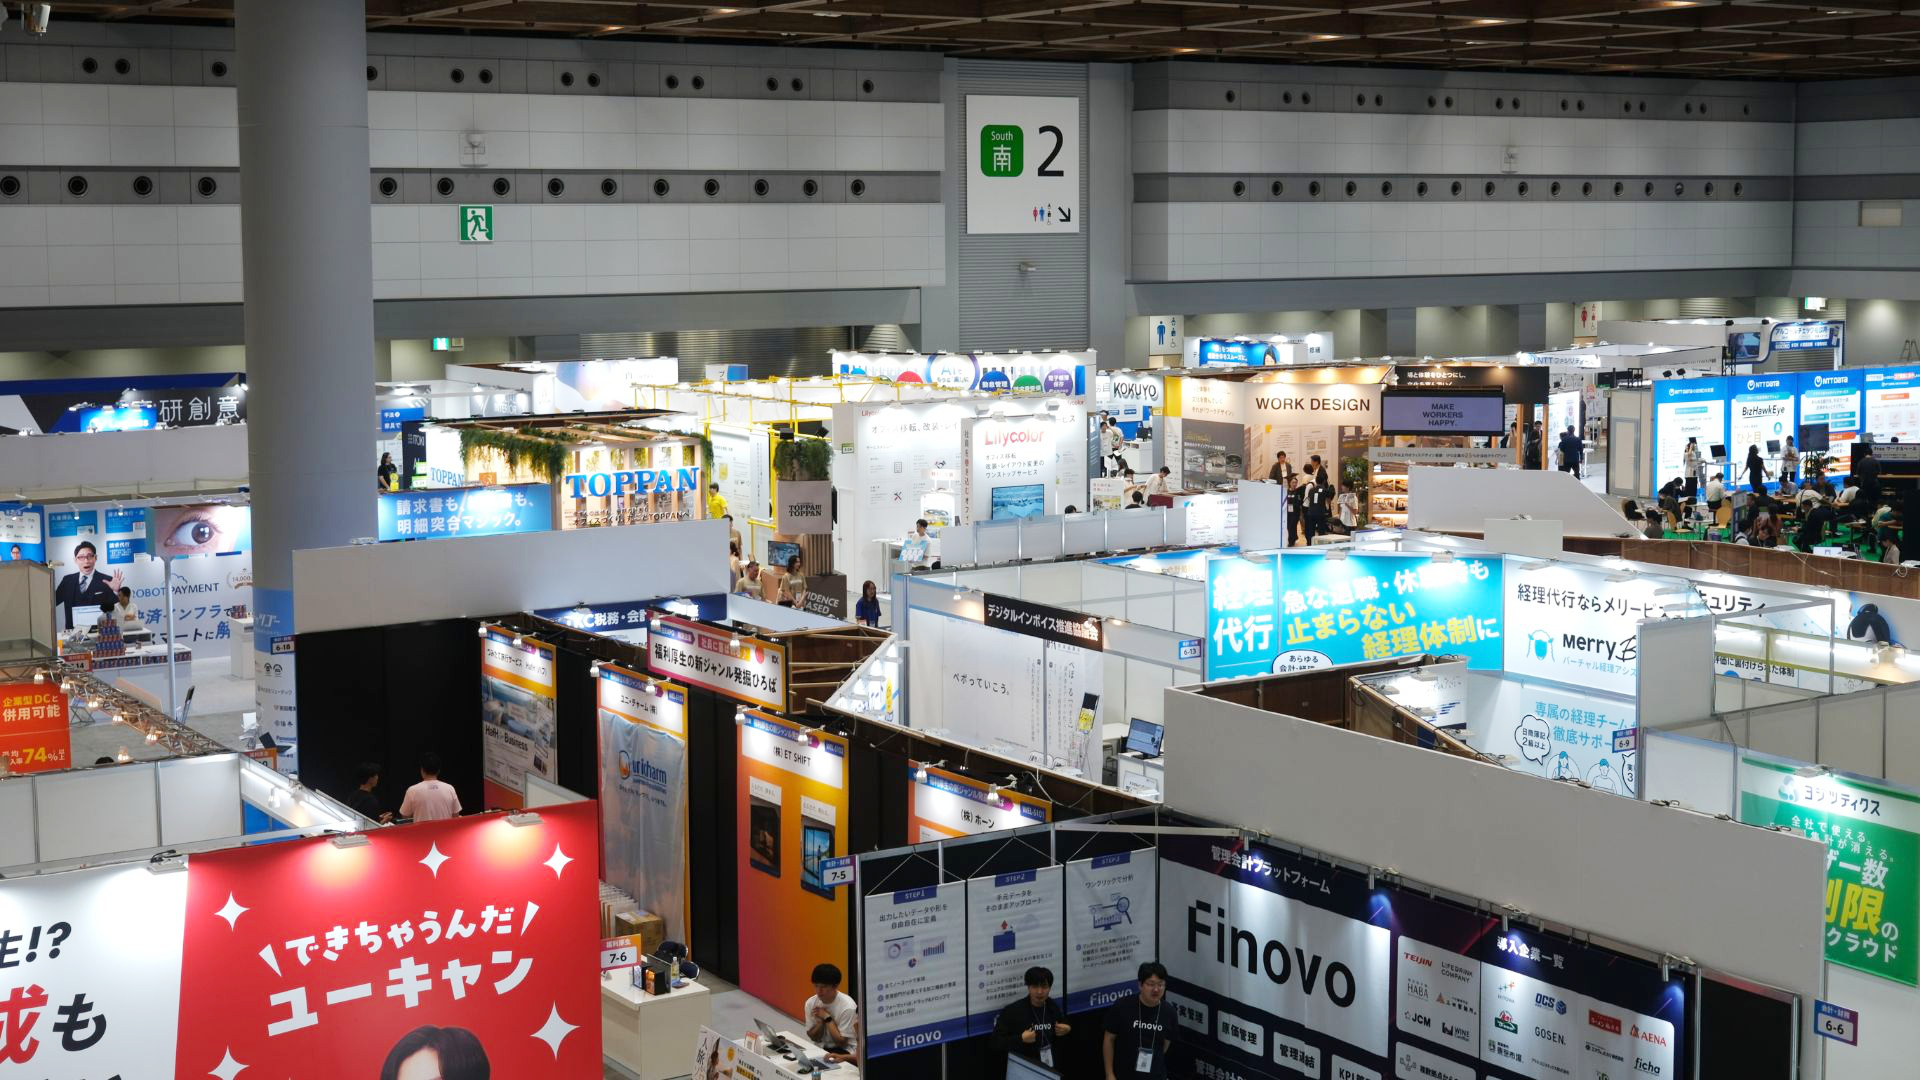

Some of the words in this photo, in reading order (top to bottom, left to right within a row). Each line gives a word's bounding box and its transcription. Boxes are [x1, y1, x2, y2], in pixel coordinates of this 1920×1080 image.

[991, 131, 1013, 141] South
[993, 144, 1011, 172] 南
[1038, 126, 1064, 176] 2
[1113, 382, 1157, 398] KOKUYO
[1256, 397, 1305, 410] WORK
[1310, 398, 1370, 411] DESIGN
[1742, 405, 1785, 416] BizHawkEye
[985, 430, 1044, 447] Lilycolor
[431, 467, 465, 488] TOPPAN
[565, 466, 700, 498] TOPPAN
[397, 512, 521, 534] 明細突合マジック。
[171, 583, 219, 596] PAYMENT
[805, 602, 829, 615] ASED
[1286, 602, 1416, 645] 止まらない
[1214, 615, 1273, 655] 代行
[1362, 615, 1500, 660] 経理体制に
[1289, 655, 1319, 664] あらゆる
[654, 643, 777, 693] 福利厚生の新ジャンル発掘ひろば
[3, 704, 61, 722] 併用可能
[505, 732, 528, 751] Business
[1522, 736, 1546, 751] 2級以上
[1619, 739, 1630, 748] 6-9
[784, 749, 792, 759] ET
[793, 752, 811, 767] SHIFT
[961, 808, 973, 824] (株)
[975, 815, 995, 829] ホーン
[832, 869, 847, 881] 7-5
[1211, 844, 1331, 895] 管理会計プラットフォーム
[1005, 874, 1026, 883] STEP2
[1085, 873, 1134, 889] ワンクリックで分析
[905, 890, 925, 899] STEP1
[997, 889, 1032, 901] 手元データを
[986, 897, 1043, 913] そのままアップロード
[879, 904, 948, 923] 出力したいデータや形を
[891, 915, 937, 930] 自由自在に定義
[286, 904, 514, 962] できちゃうんだ
[1187, 899, 1356, 1008] Finovo
[1497, 935, 1565, 970] 導入企業一覧
[1827, 928, 1897, 963] クラウド
[610, 952, 627, 963] 7-6
[1404, 952, 1433, 967] TEIJIN
[1441, 969, 1470, 984] COMPANY
[267, 949, 534, 1037] ユーキャン
[1407, 982, 1429, 999] HABA
[1821, 1004, 1850, 1019] 会計・財務
[1133, 1019, 1163, 1032] Finovo
[1411, 1013, 1431, 1028] JCM
[1826, 1020, 1844, 1035] 6-6
[894, 1029, 942, 1050] Finovo
[1222, 1022, 1257, 1045] 原価管理
[1454, 1027, 1470, 1038] WINE
[1641, 1031, 1667, 1047] AENA
[1634, 1057, 1661, 1074] ficha
